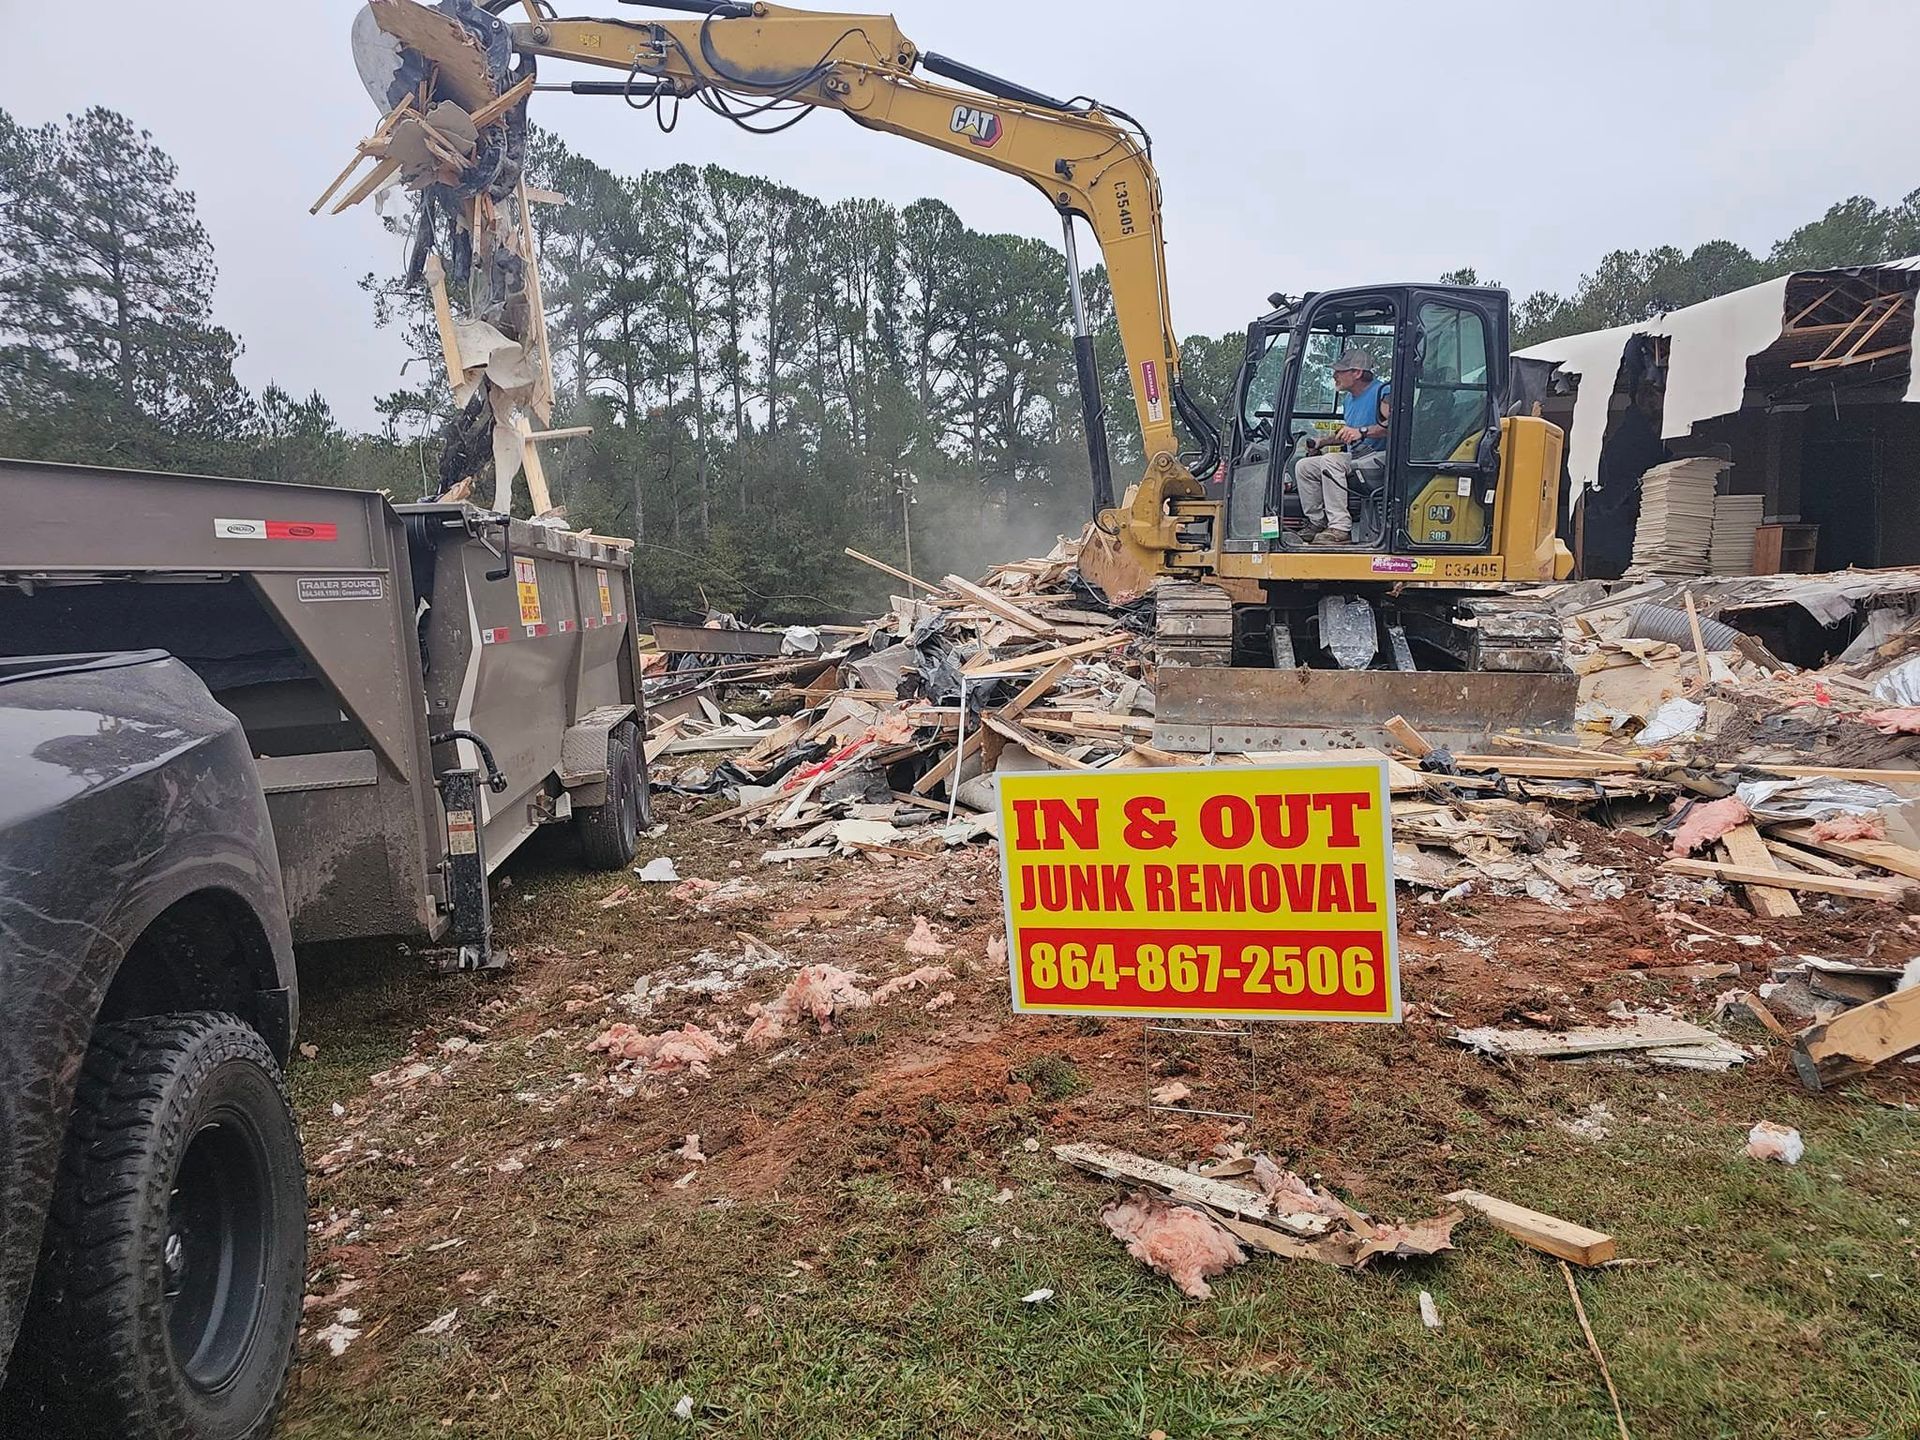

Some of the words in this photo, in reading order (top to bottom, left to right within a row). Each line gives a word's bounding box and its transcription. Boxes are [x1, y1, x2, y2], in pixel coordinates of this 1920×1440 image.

[950, 105, 994, 139] CAT
[1114, 181, 1135, 235] C35405
[1429, 506, 1450, 520] CAT
[1430, 531, 1447, 541] 308
[301, 581, 339, 590] TRAILER
[341, 580, 377, 588] SOURCE
[1445, 563, 1498, 577] C35405
[1012, 798, 1100, 851] IN
[1123, 796, 1178, 850] &
[1199, 792, 1372, 850] OUT
[1020, 864, 1134, 912] JUNK
[1143, 863, 1377, 914] REMOVAL
[1029, 942, 1376, 997] 864-867-2506
